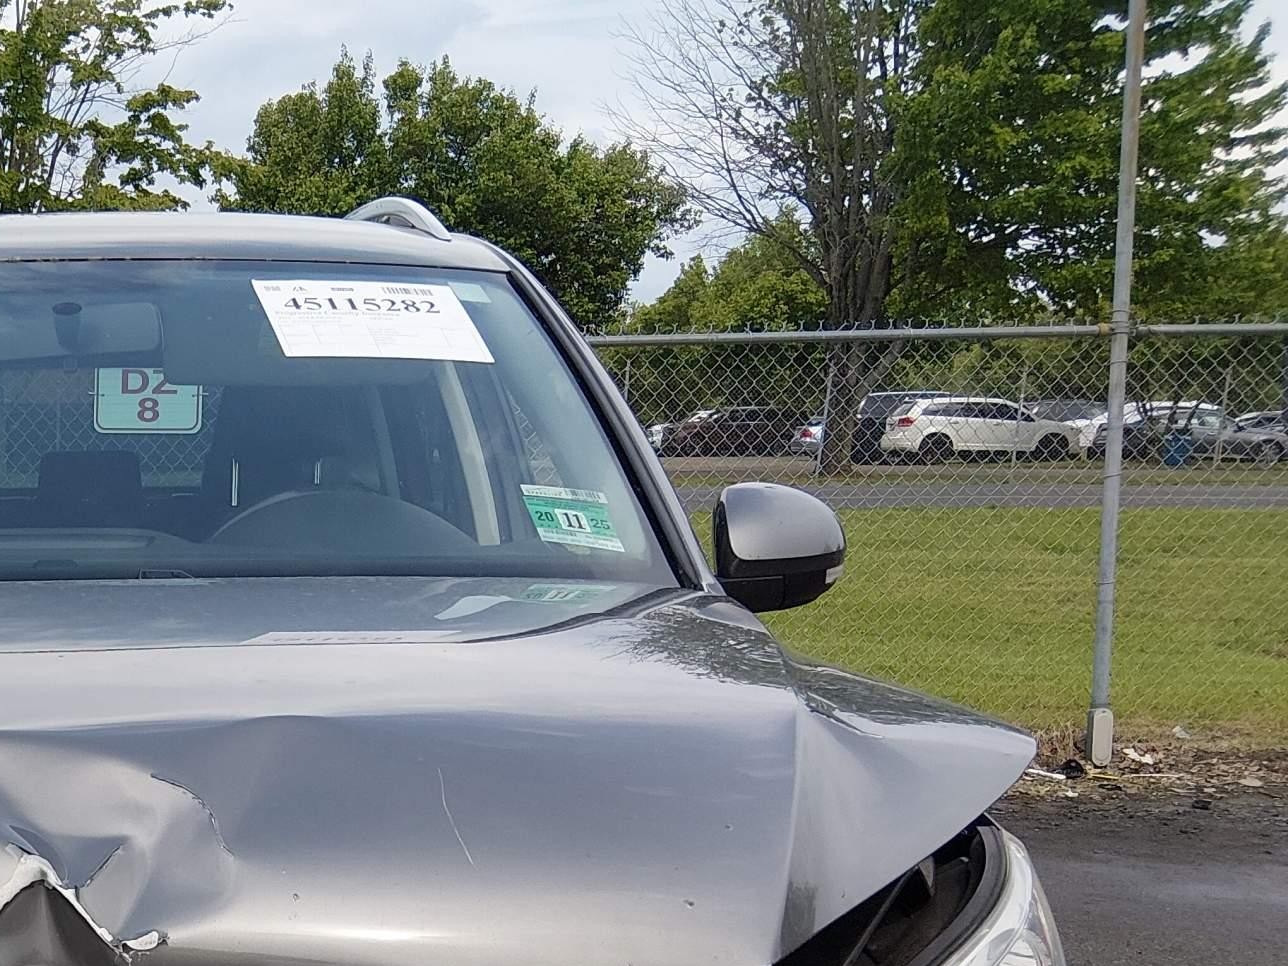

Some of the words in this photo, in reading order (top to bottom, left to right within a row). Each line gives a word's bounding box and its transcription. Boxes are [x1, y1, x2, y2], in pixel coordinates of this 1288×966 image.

[283, 297, 441, 314] 45115282
[137, 397, 160, 423] 8
[535, 510, 555, 522] 20
[562, 512, 586, 530] 11
[590, 518, 610, 530] 25
